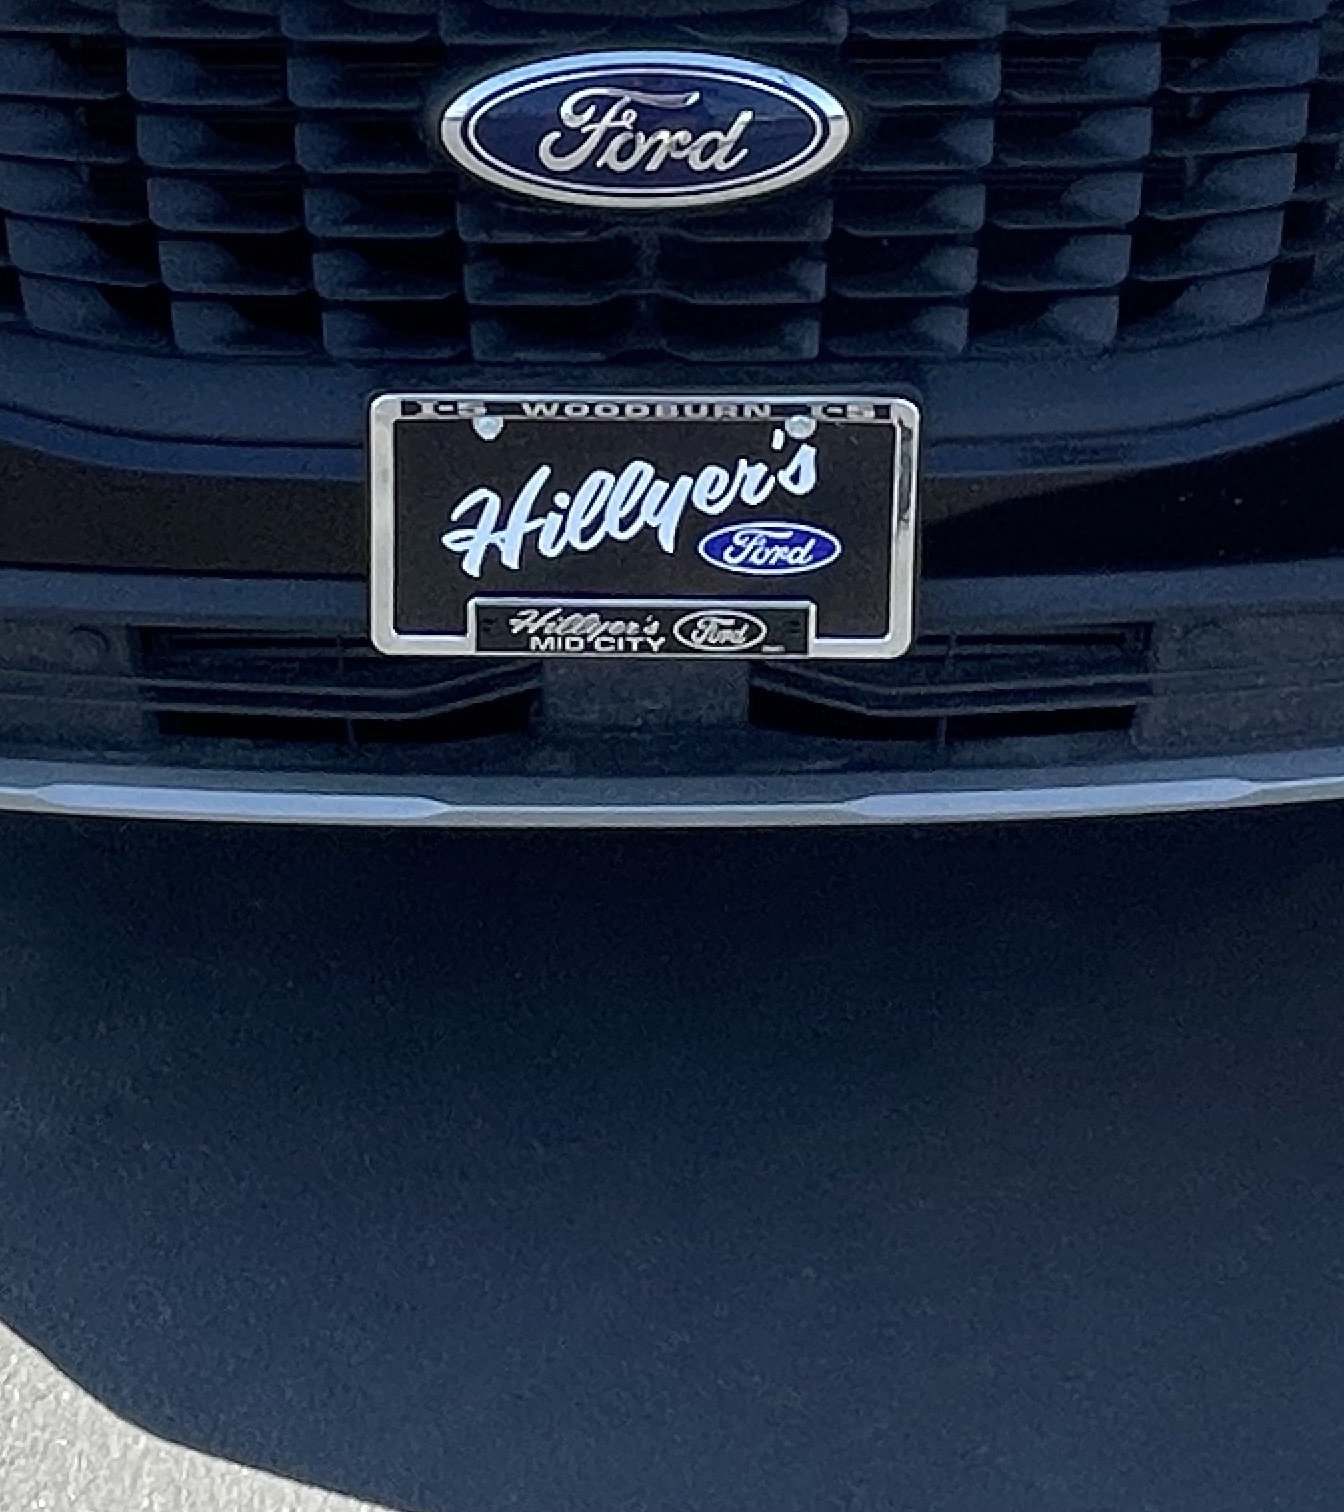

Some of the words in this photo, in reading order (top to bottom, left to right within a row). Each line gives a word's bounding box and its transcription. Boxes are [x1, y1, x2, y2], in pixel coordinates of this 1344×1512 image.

[538, 87, 754, 173] Ford
[522, 402, 770, 417] WOODBURN
[442, 428, 817, 578] Hillyer's
[723, 530, 814, 565] Ford
[509, 608, 660, 642] Hillyer's
[690, 616, 749, 644] Ford
[530, 637, 584, 651] MID
[594, 637, 666, 651] CITY
